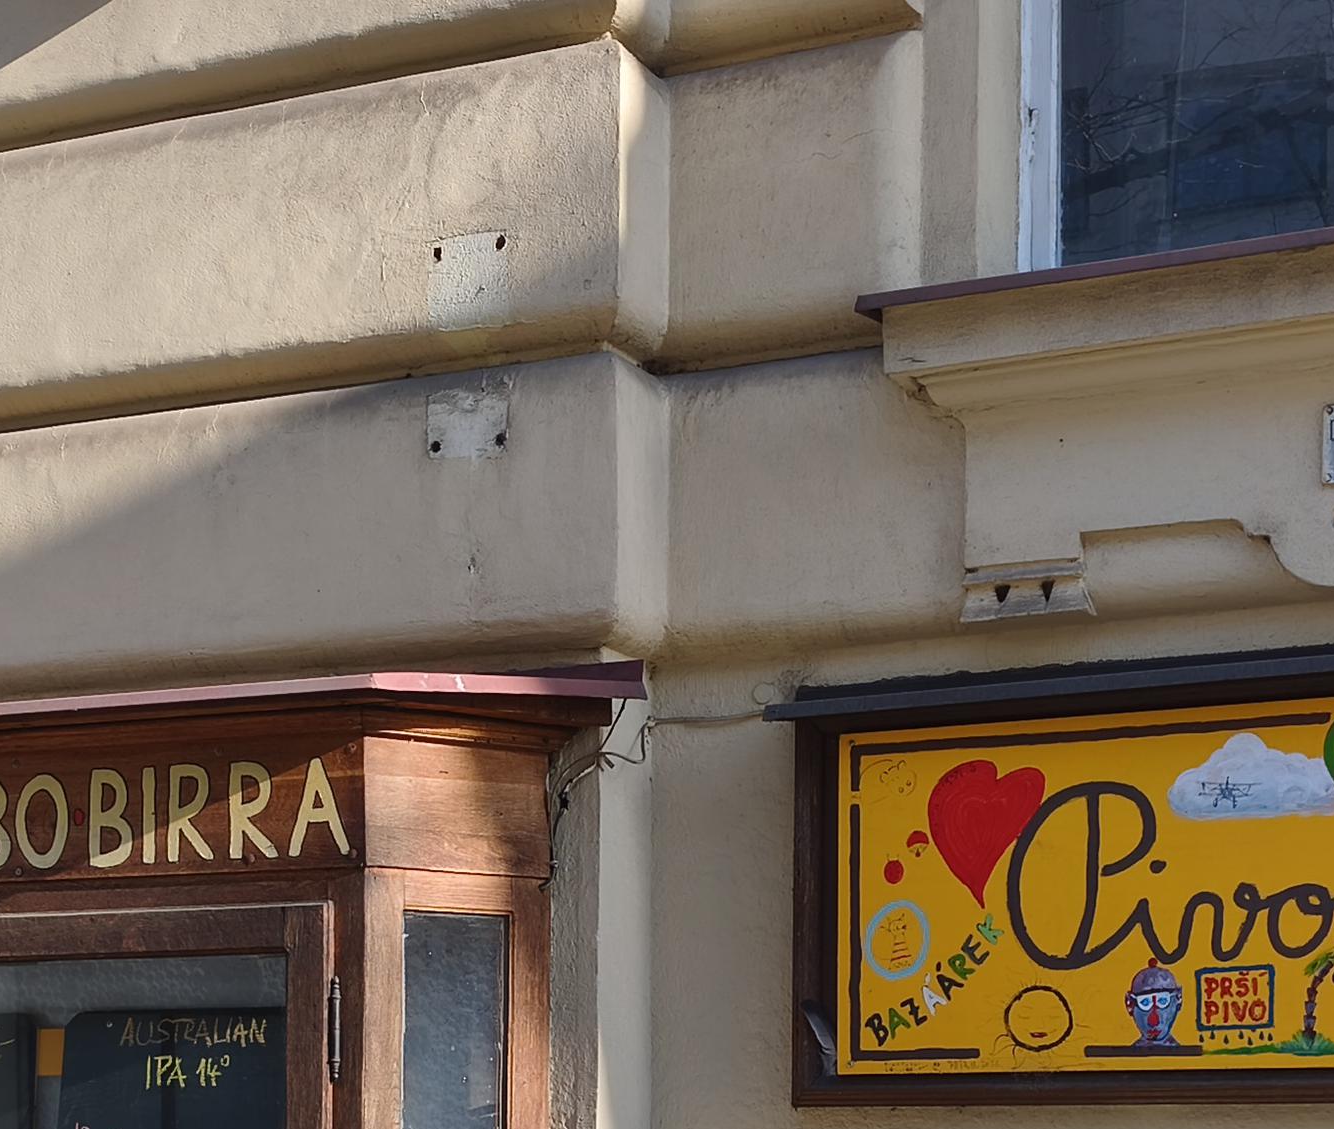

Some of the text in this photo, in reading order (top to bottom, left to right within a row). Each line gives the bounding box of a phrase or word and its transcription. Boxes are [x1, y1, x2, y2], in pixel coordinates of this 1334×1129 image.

[89, 757, 351, 868] BIRRA
[865, 913, 1005, 1047] BAZÁÁREK
[1204, 971, 1268, 999] PRŠÍ
[1204, 998, 1267, 1024] PIVO
[145, 1054, 231, 1090] IPA 14°
